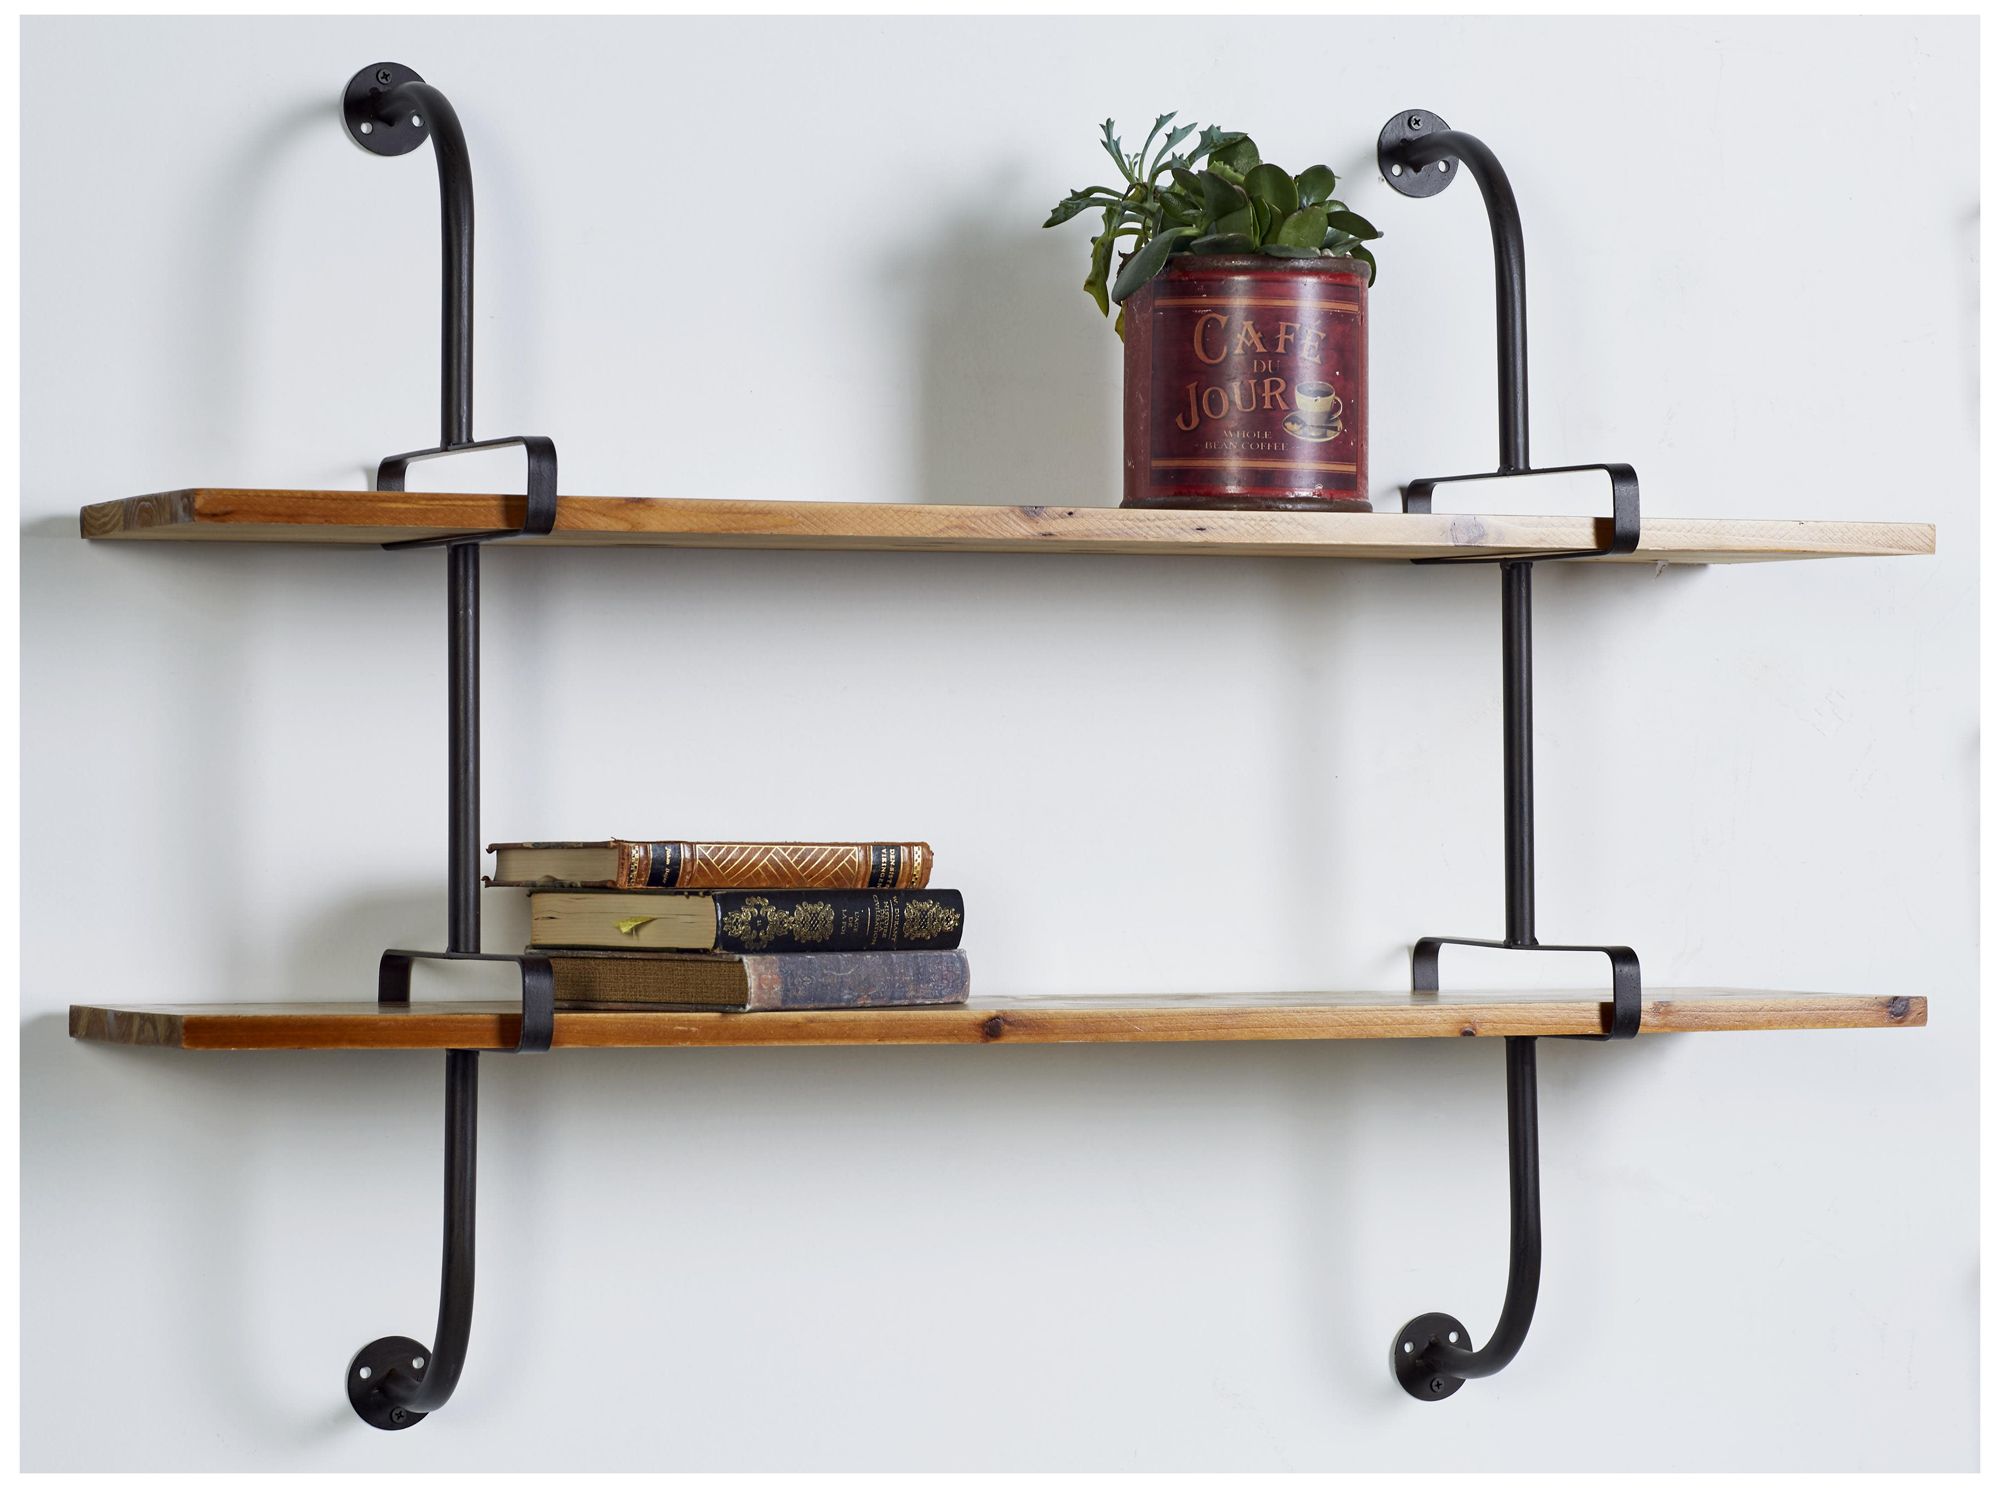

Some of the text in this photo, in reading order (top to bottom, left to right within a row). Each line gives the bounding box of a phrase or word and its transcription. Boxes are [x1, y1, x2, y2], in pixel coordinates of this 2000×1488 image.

[1193, 312, 1327, 365] CAFÉ
[1252, 358, 1280, 374] DU
[1176, 376, 1290, 432] JOUR
[1204, 441, 1289, 451] BEAN COFFEE
[1223, 430, 1272, 440] WHOLE
[871, 894, 881, 945] CIVILISATION
[891, 908, 900, 942] DURANT
